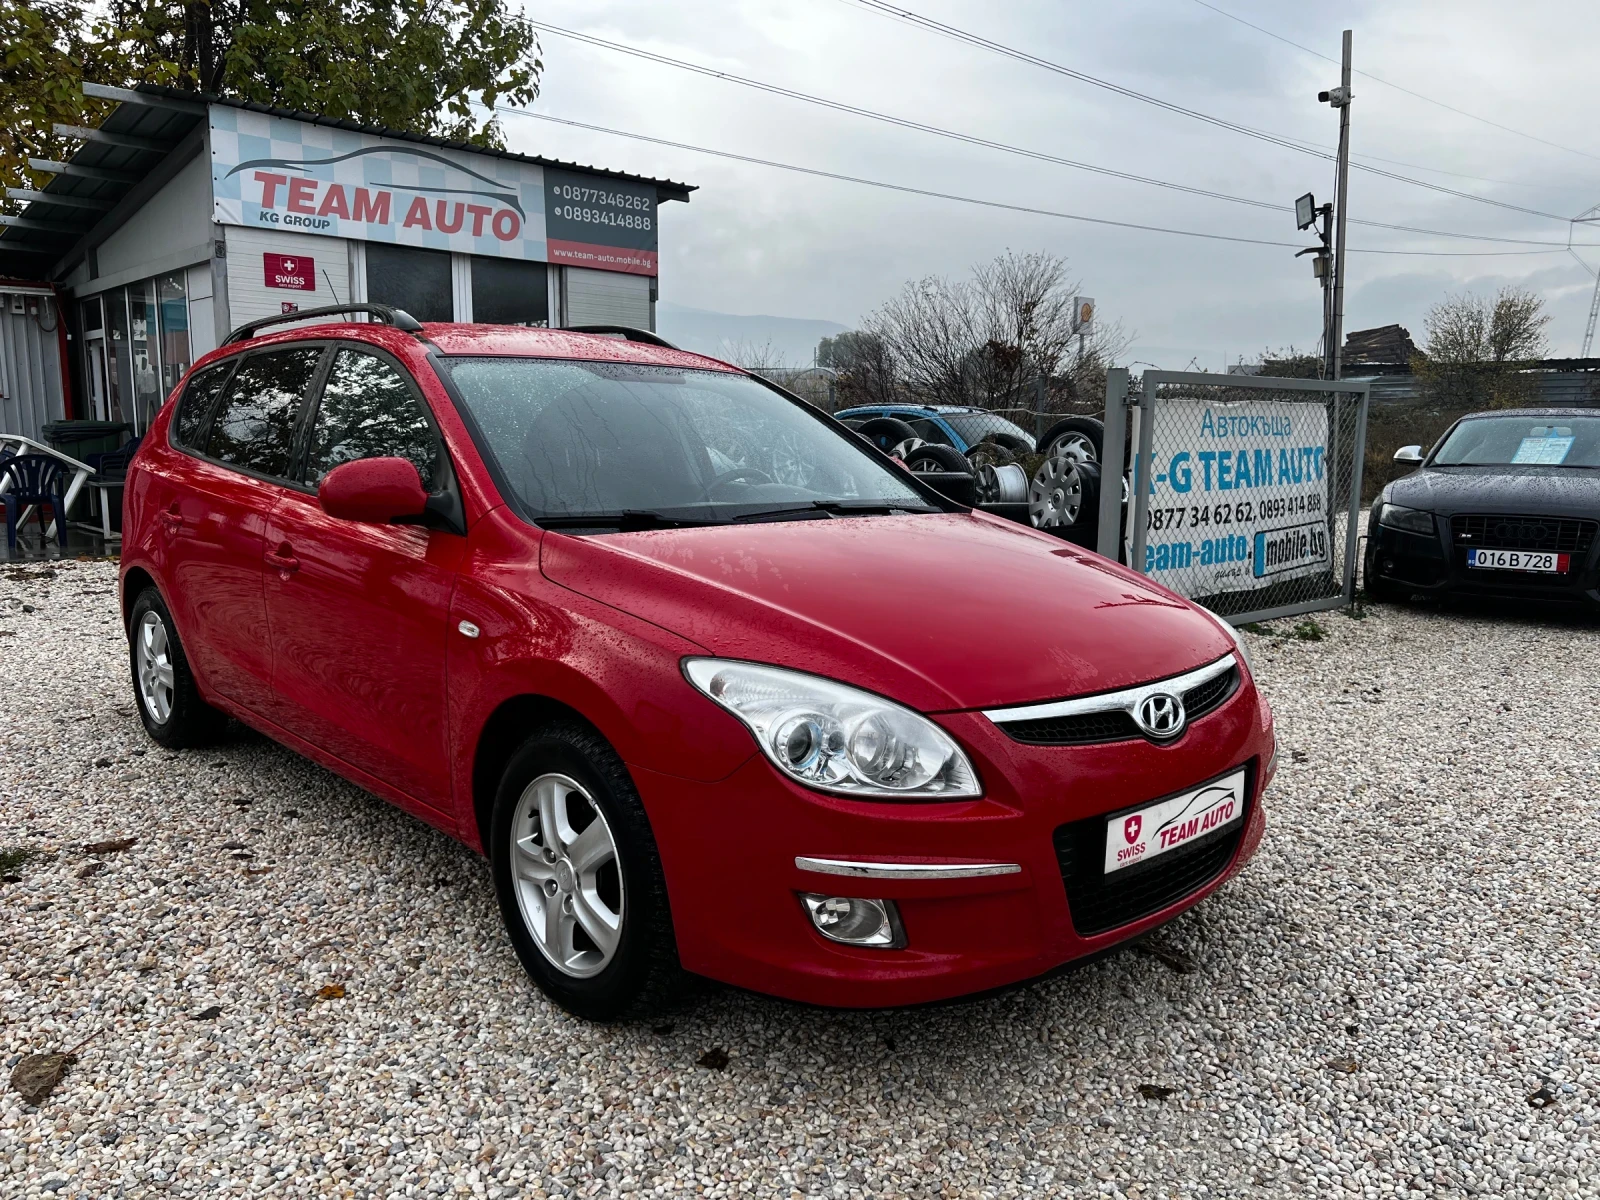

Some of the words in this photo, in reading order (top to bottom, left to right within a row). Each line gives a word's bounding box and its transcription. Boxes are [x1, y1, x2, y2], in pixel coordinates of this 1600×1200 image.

[254, 171, 392, 225] TEAM
[403, 196, 521, 242] AUTO
[563, 185, 650, 211] 0877346262
[259, 212, 281, 224] KG
[283, 213, 330, 230] GROUP
[564, 206, 651, 230] 0893414888
[553, 249, 651, 268] www.team-auto.mobile.bg
[275, 275, 305, 285] SWISS
[1200, 408, 1292, 438] Автокъща
[1198, 449, 1273, 491] TEAM
[1278, 446, 1325, 485] AUTO
[1190, 505, 1209, 528] 34
[1214, 503, 1232, 525] 62
[1235, 502, 1257, 524] 62,
[1260, 498, 1285, 520] 0893
[1288, 495, 1305, 515] 414
[1307, 493, 1321, 512] 888
[1131, 533, 1252, 572] eam-auto.
[1266, 527, 1325, 566] mobile.bg
[1478, 552, 1506, 566] 016
[1509, 553, 1520, 567] B
[1523, 554, 1553, 569] 728
[1160, 817, 1199, 849] TEAM
[1201, 801, 1234, 832] AUTO
[1117, 842, 1146, 862] SWISS
